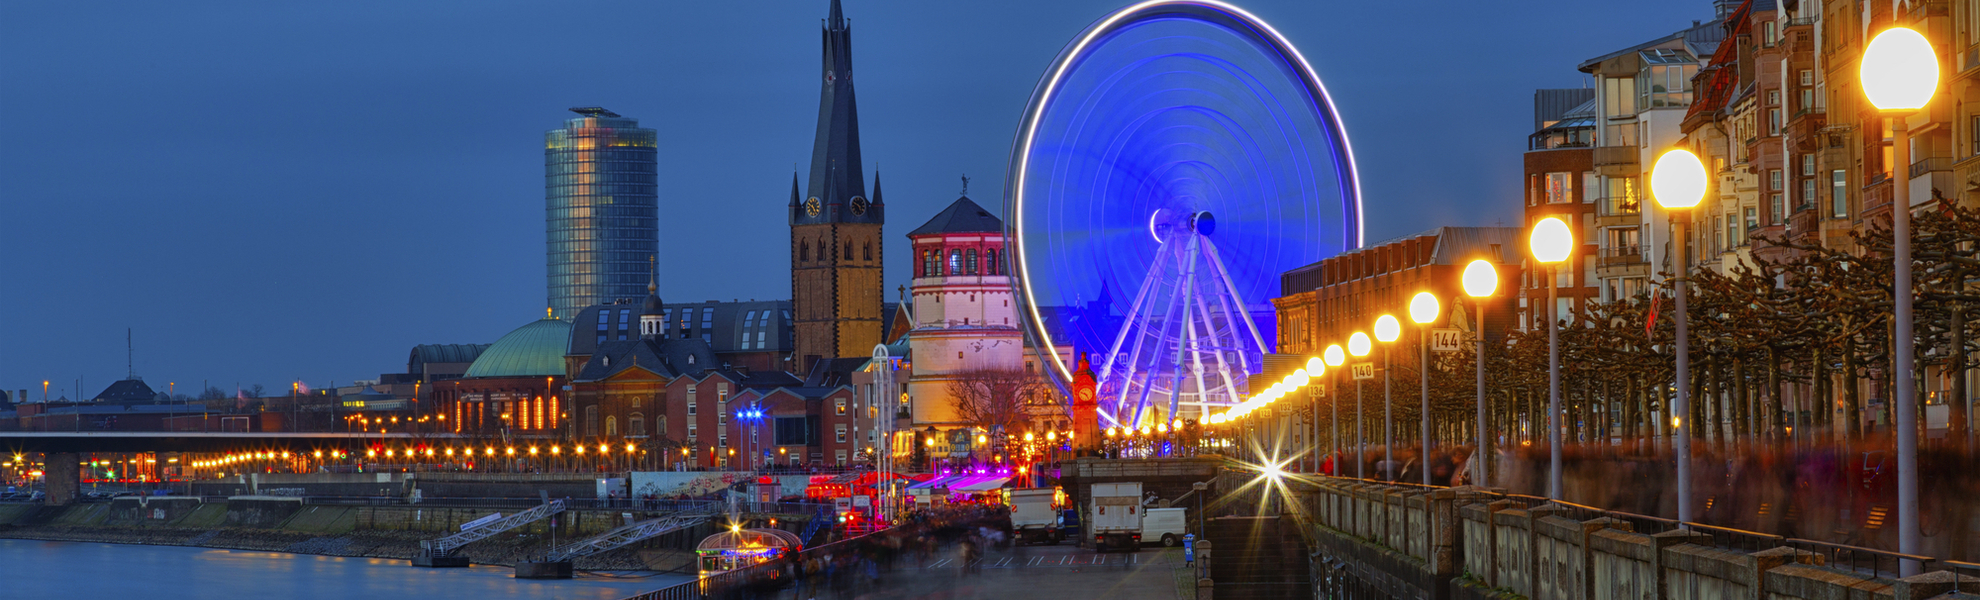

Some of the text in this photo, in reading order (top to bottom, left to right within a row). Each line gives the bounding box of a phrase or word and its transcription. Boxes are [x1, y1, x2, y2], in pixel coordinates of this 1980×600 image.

[1434, 332, 1458, 348] 144
[1354, 365, 1371, 378] 140
[1310, 386, 1323, 395] 136
